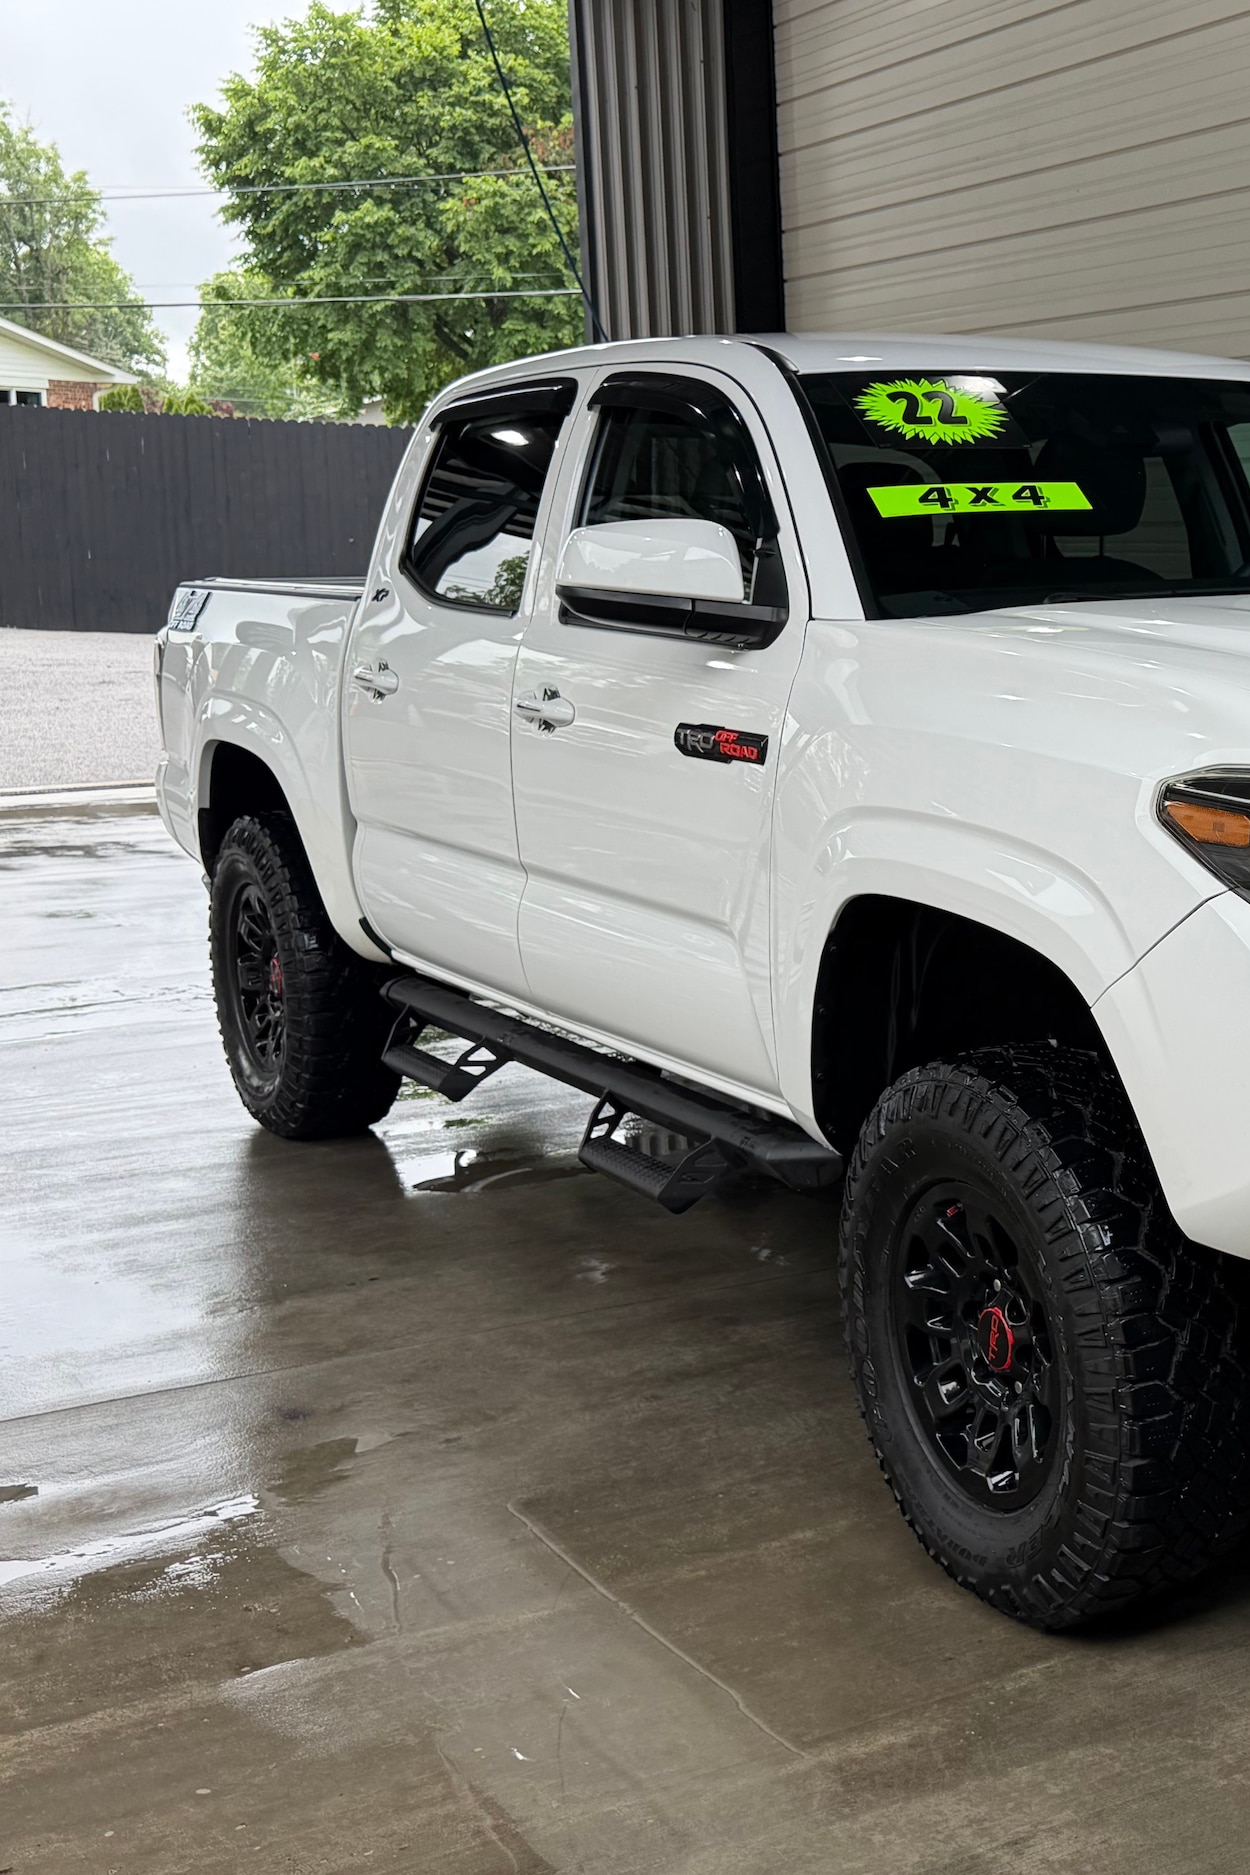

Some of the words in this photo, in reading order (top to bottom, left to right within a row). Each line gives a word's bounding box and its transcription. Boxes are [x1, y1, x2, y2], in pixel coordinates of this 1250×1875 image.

[886, 390, 968, 426] 22
[677, 728, 715, 753] TRD
[715, 730, 739, 743] OFF
[720, 743, 759, 760] ROAD
[988, 1314, 1000, 1361] TRD
